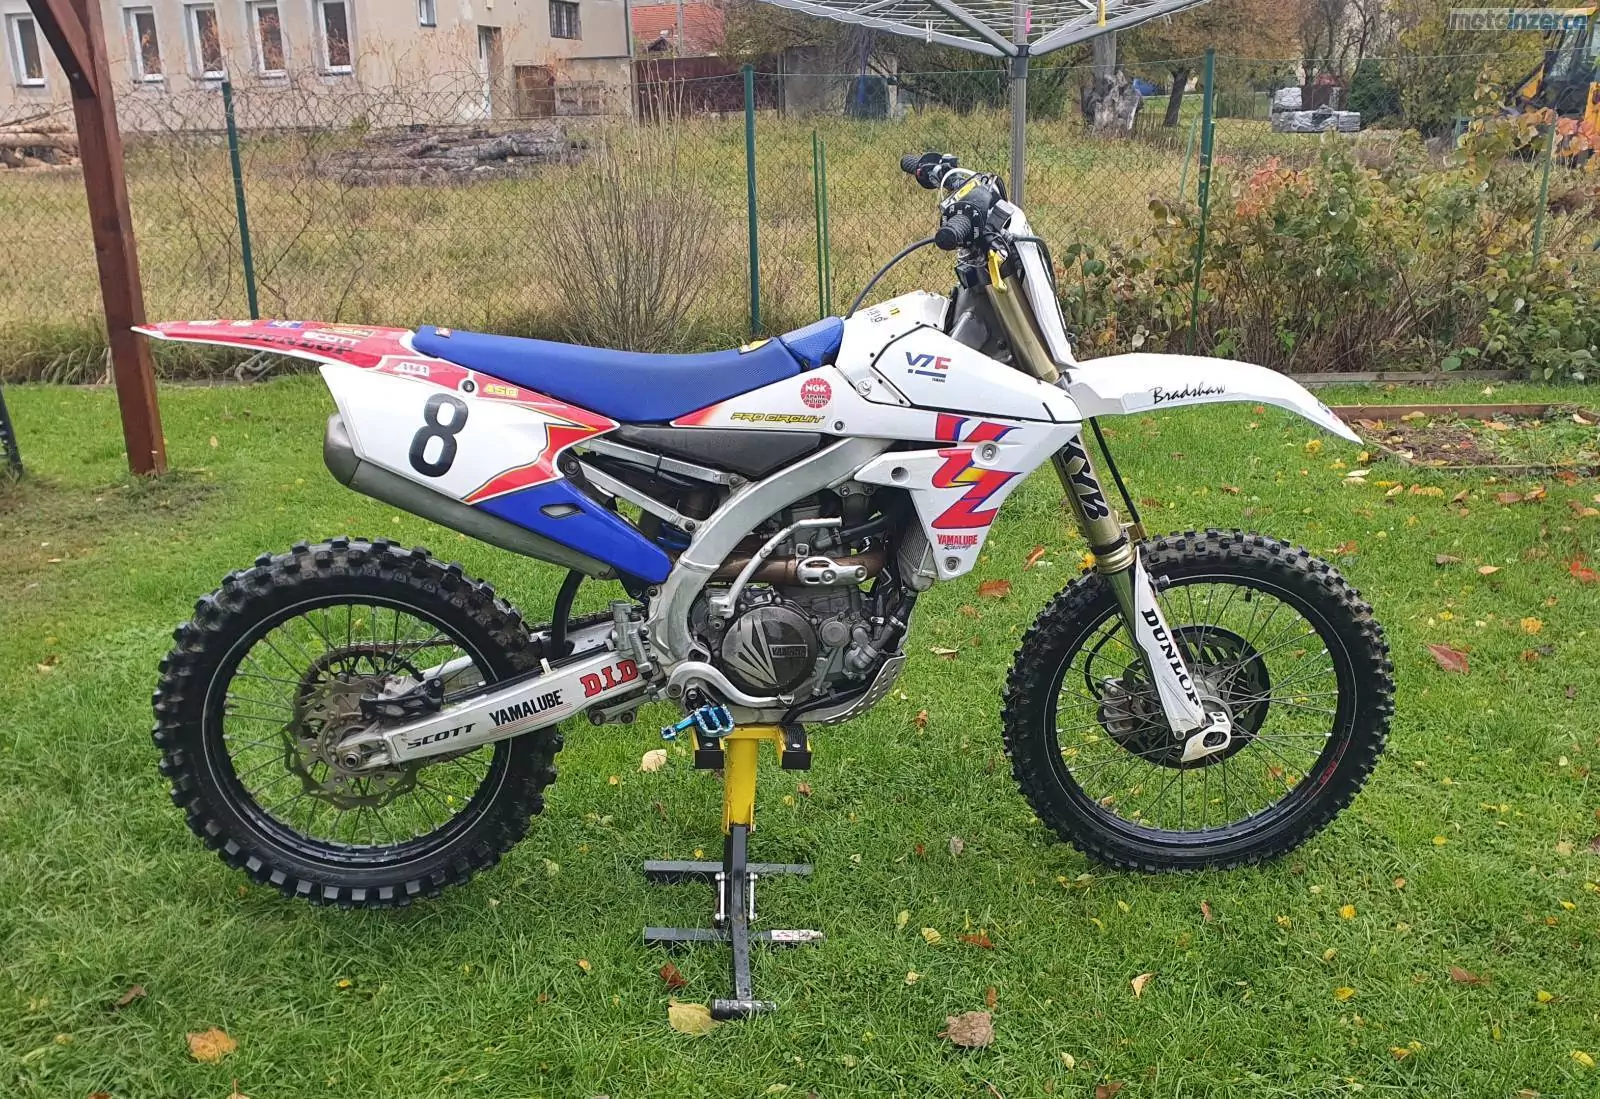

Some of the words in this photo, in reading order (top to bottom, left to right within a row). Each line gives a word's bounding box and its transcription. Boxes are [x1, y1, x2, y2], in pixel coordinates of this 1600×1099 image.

[806, 384, 827, 392] NGK
[1150, 382, 1226, 405] Bradshaw
[409, 393, 469, 477] 8
[730, 412, 765, 422] PRO
[765, 413, 826, 424] CIRCUIT
[1061, 434, 1110, 520] KYB
[937, 534, 978, 545] YAMALUBE
[1141, 608, 1201, 707] DUNLOP
[406, 722, 477, 750] SCOTT
[488, 688, 563, 727] YAMALUBE
[579, 658, 639, 698] D.I.D
